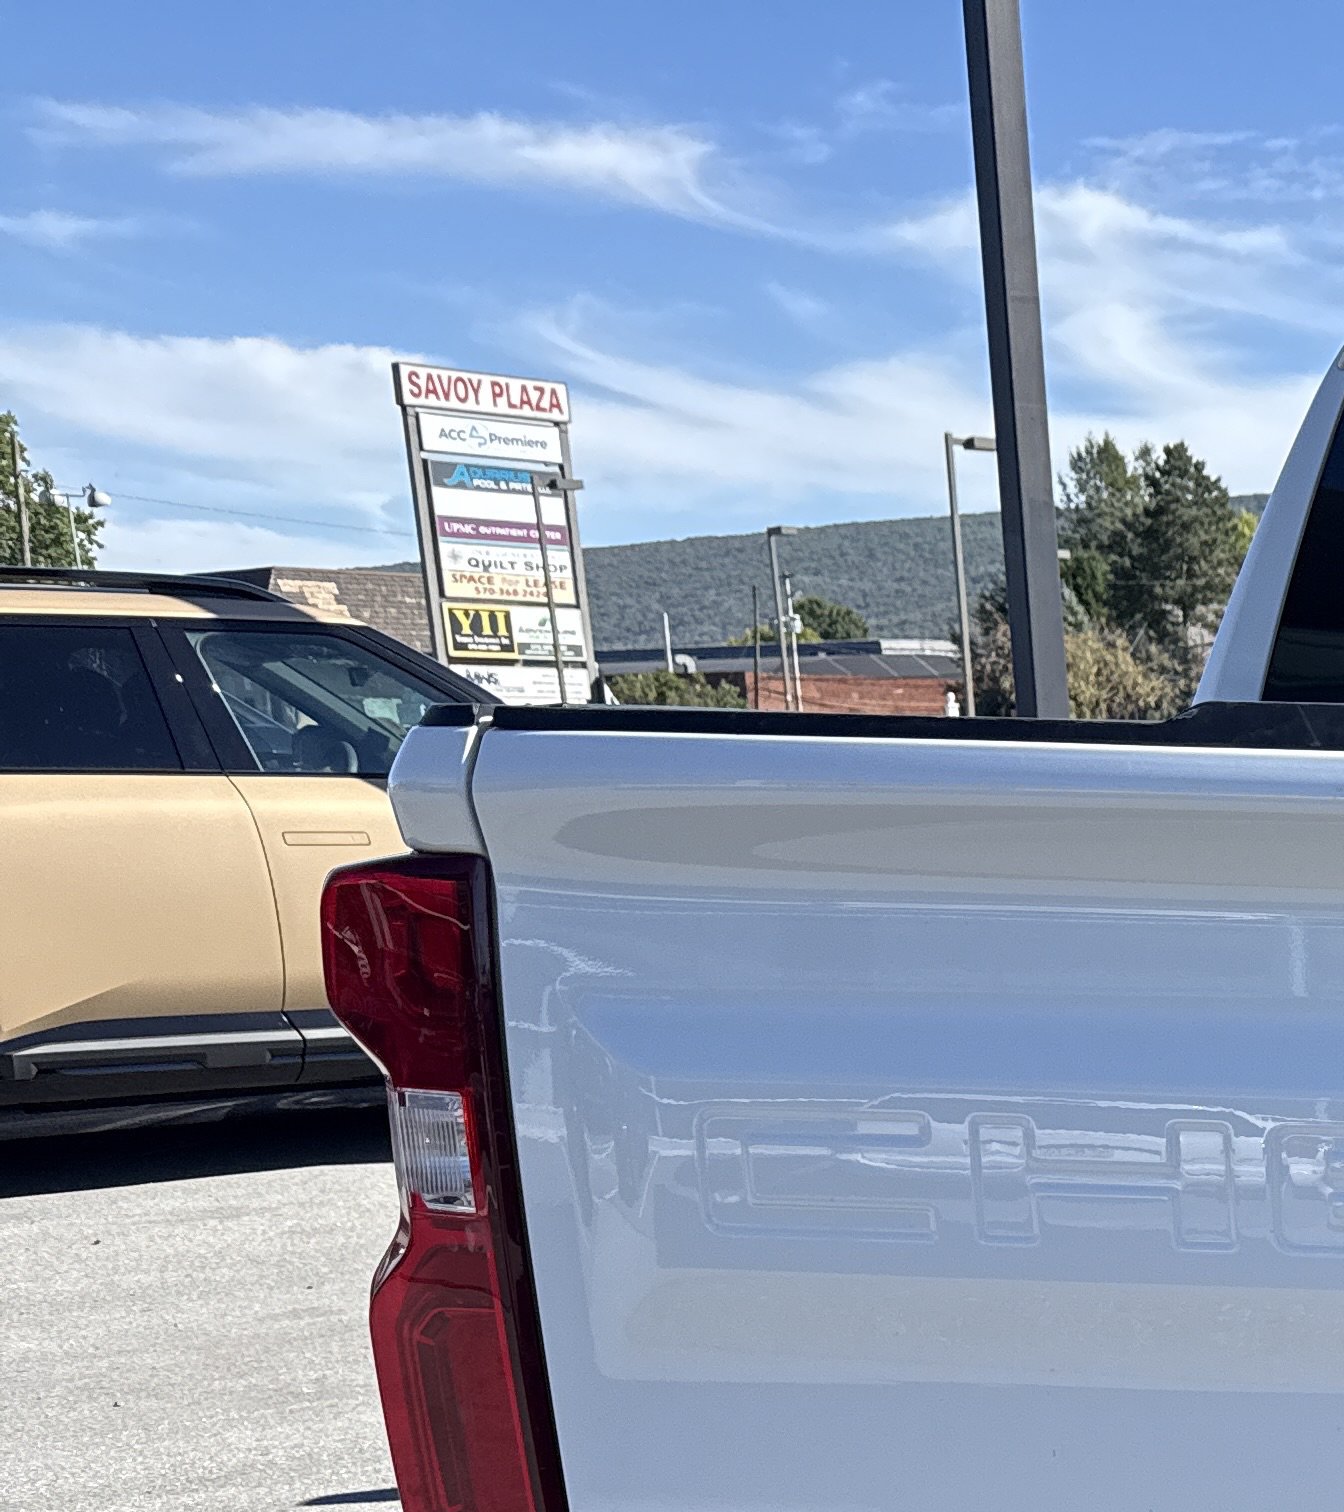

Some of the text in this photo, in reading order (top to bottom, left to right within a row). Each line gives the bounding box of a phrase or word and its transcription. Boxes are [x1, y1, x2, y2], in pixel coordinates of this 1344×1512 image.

[407, 370, 564, 415] SAVOY PLAZA
[438, 427, 548, 450] ACC Premiere
[443, 521, 477, 535] UPMC
[467, 557, 518, 573] QUILT
[451, 573, 495, 586] SPACE
[451, 609, 510, 637] YII
